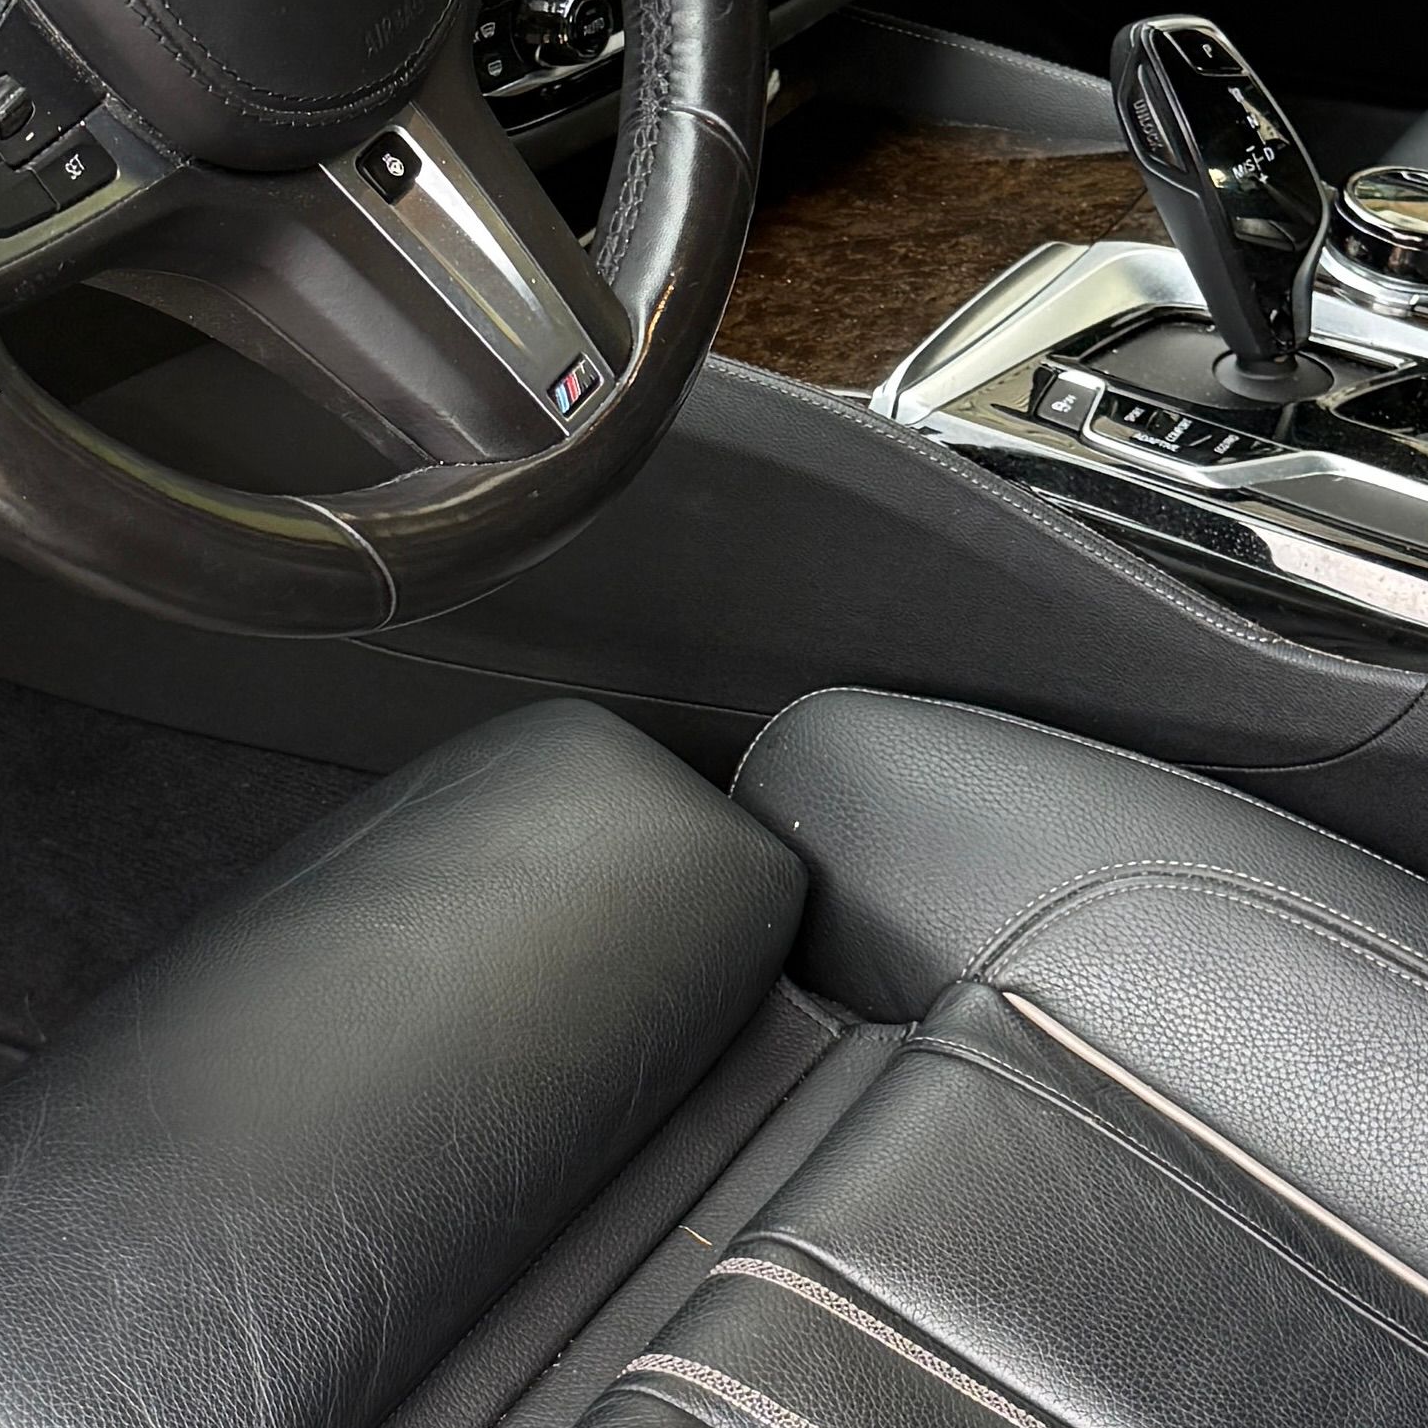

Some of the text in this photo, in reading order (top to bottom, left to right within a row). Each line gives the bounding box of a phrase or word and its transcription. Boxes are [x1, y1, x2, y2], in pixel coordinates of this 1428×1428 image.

[1202, 43, 1213, 59] P
[1133, 98, 1163, 152] UNLOCK
[1263, 146, 1275, 162] D
[65, 153, 85, 180] SET
